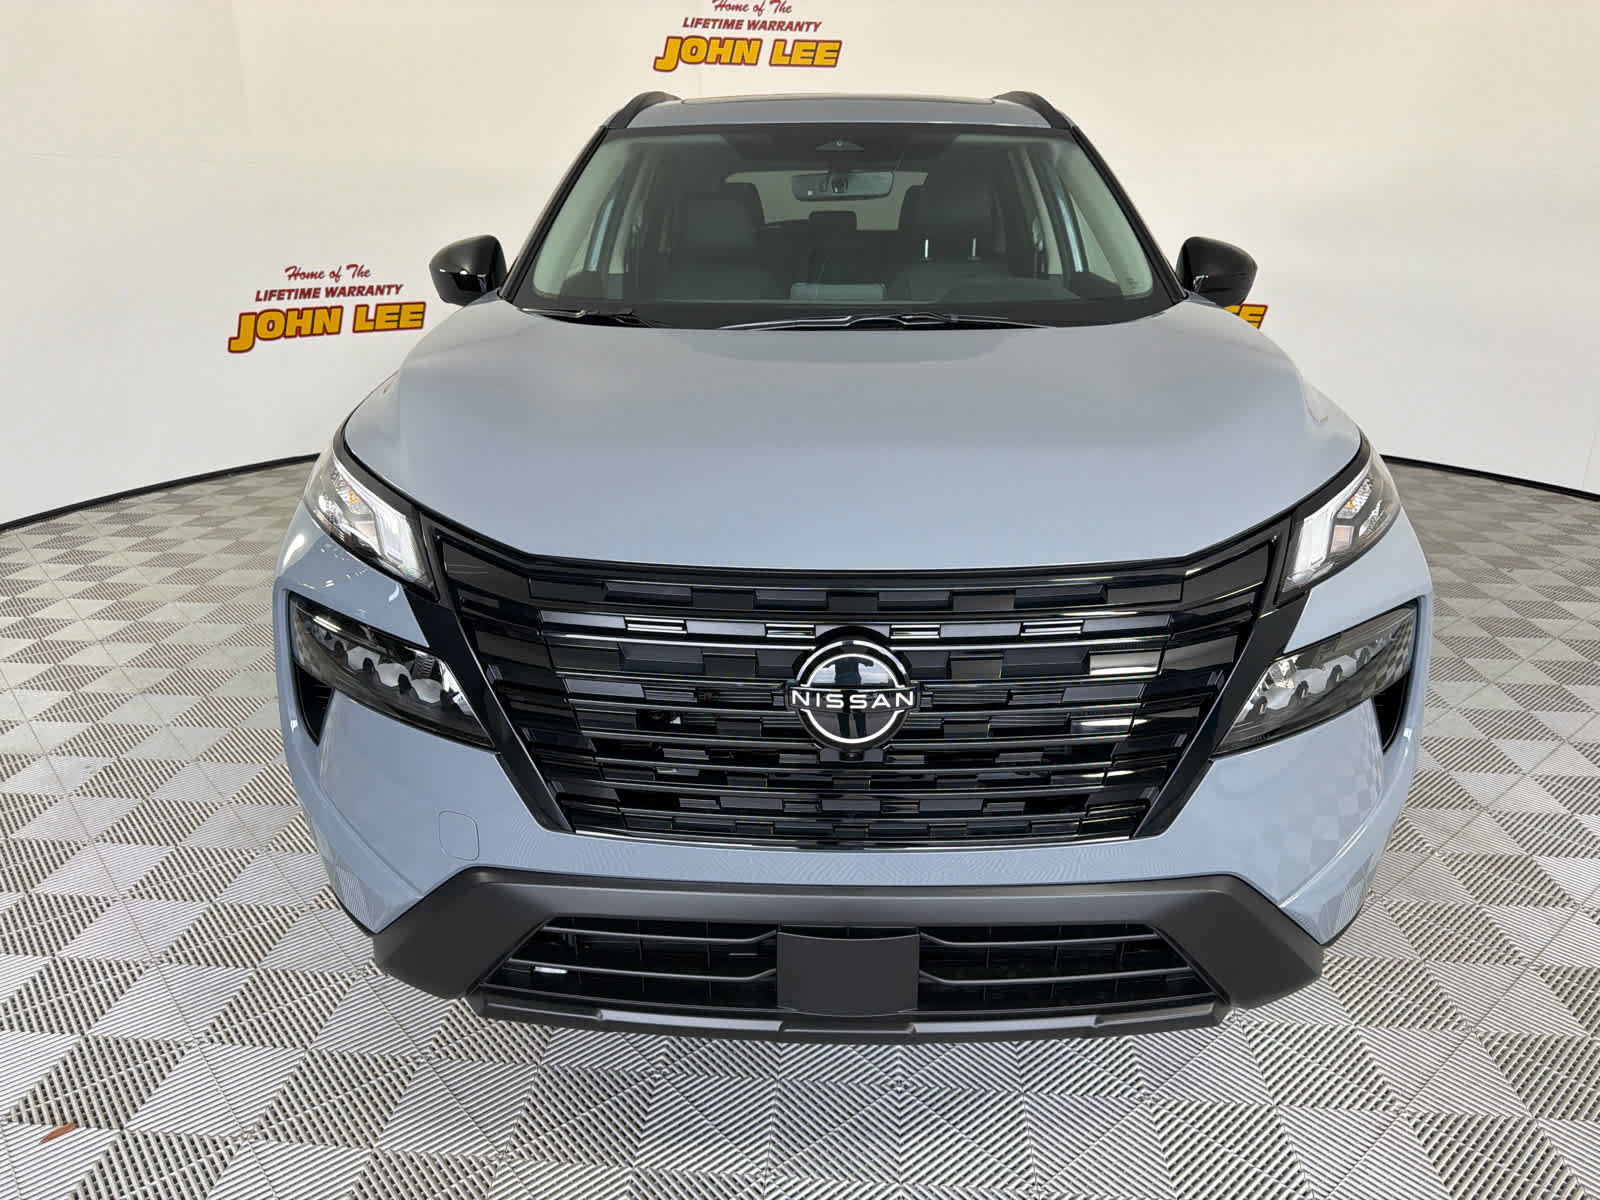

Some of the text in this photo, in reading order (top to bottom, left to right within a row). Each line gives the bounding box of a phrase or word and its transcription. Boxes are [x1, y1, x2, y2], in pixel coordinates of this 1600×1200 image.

[711, 0, 792, 17] Home of The
[682, 17, 822, 32] LIFETIME WARRANTY
[653, 35, 843, 72] JOHN LEE
[284, 263, 371, 283] Home of The
[255, 284, 404, 302] LIFETIME WARRANTY
[227, 301, 426, 354] JOHN LEE
[791, 690, 914, 709] NISSAN
